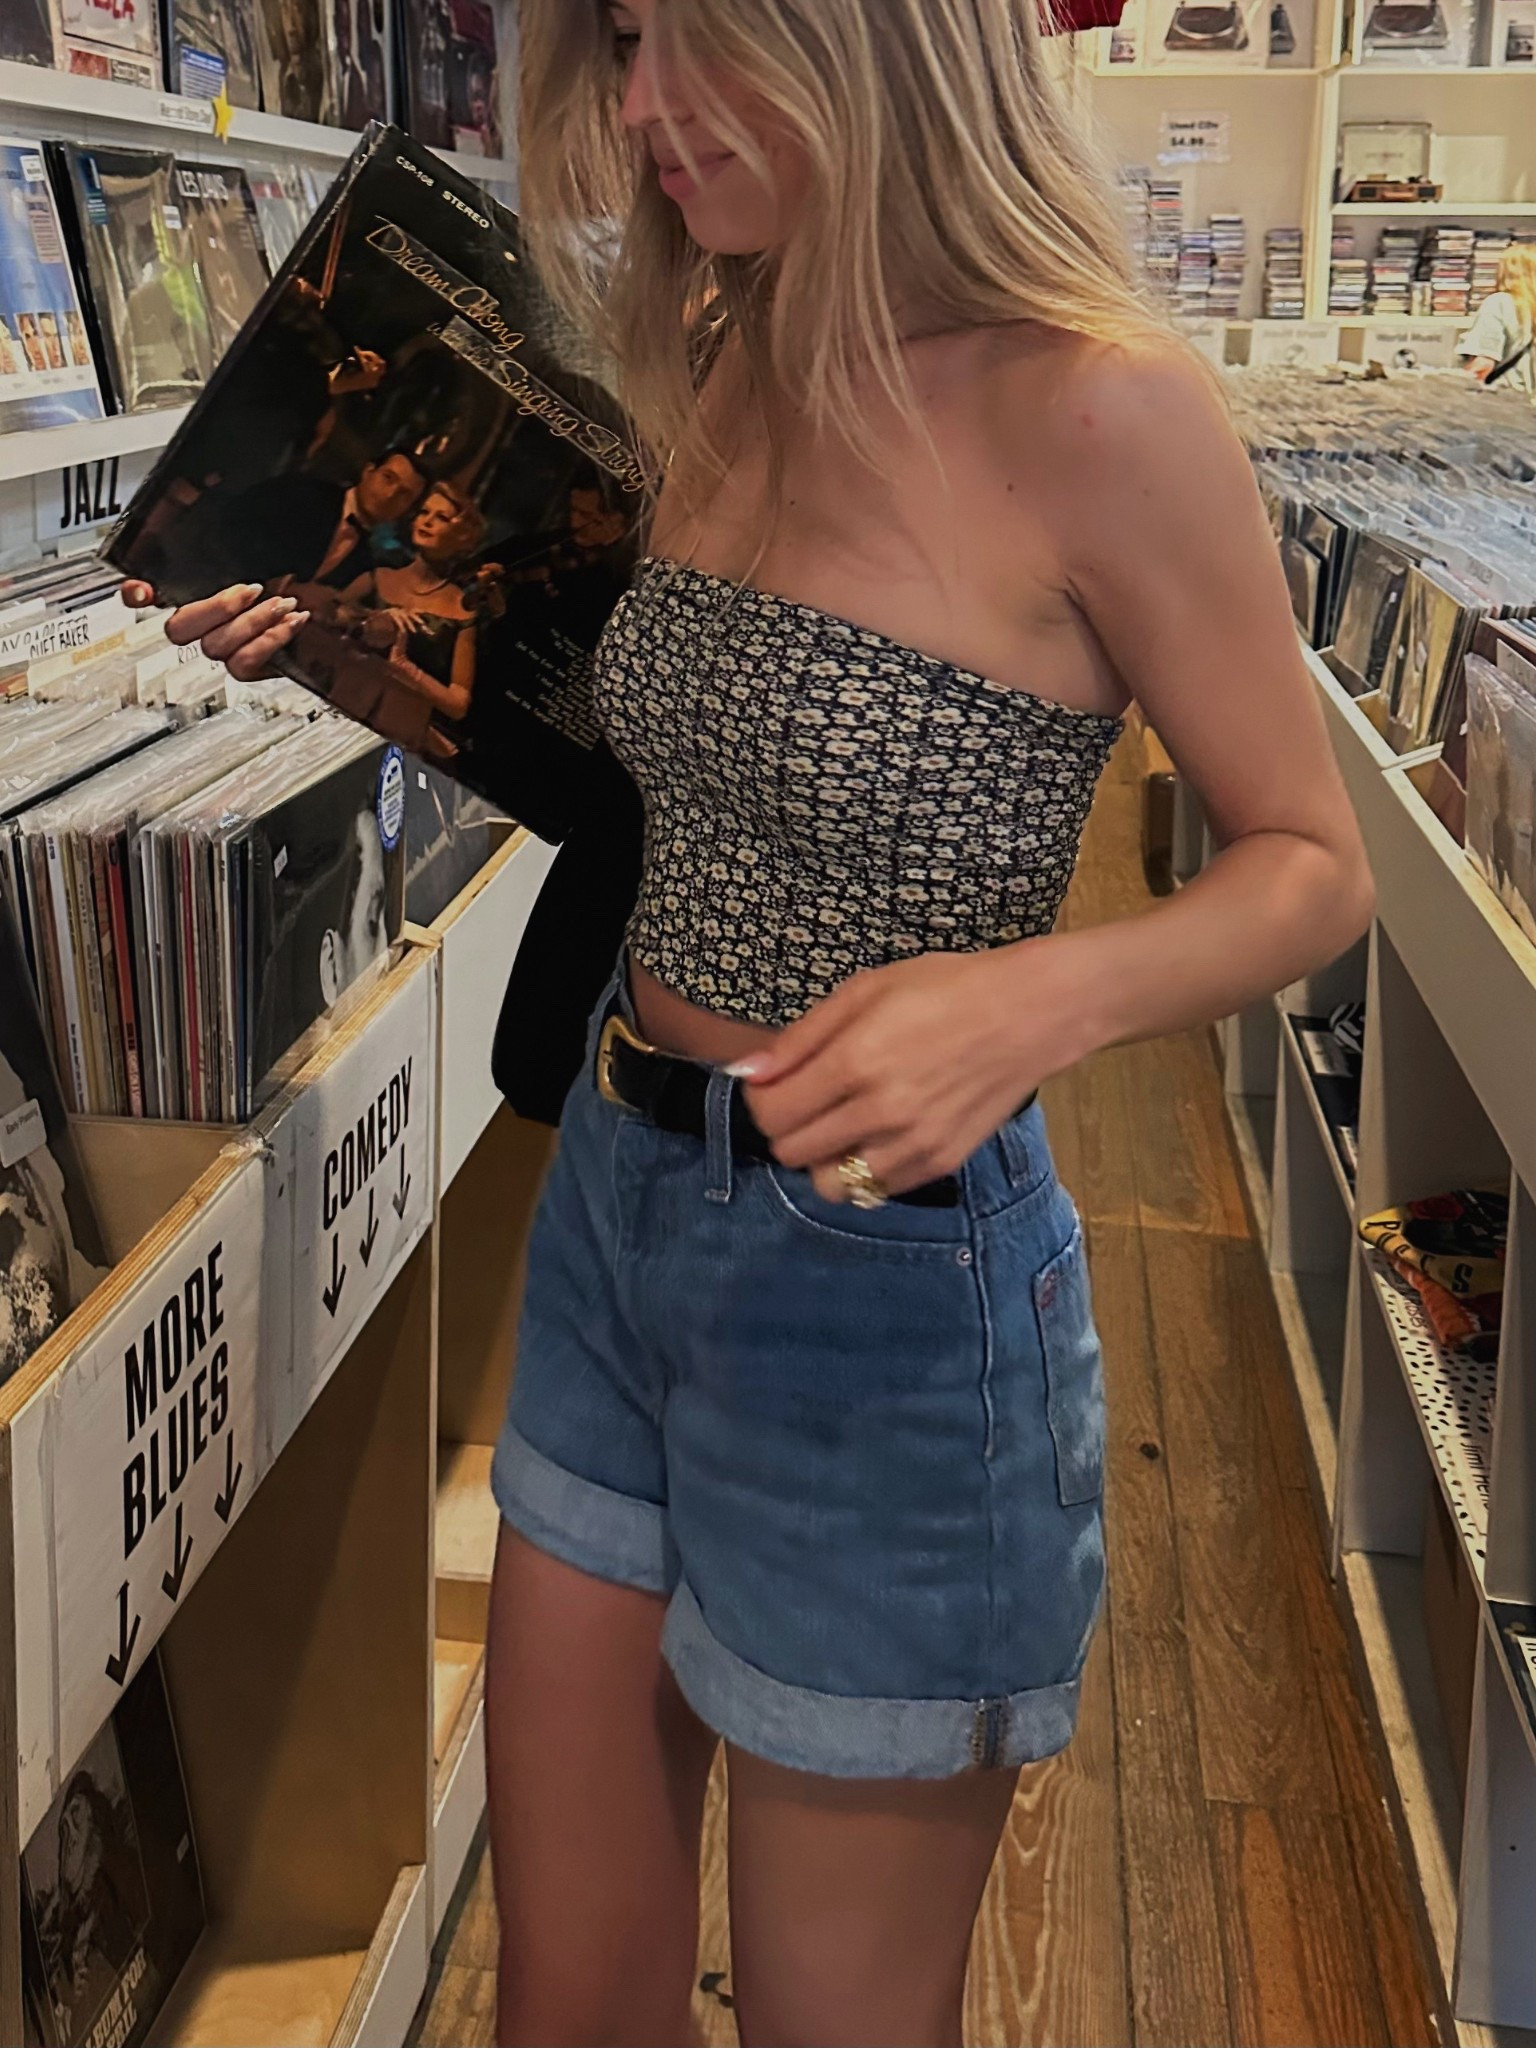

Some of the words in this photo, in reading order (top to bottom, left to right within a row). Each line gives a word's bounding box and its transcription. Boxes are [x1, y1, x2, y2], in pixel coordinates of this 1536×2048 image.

[442, 190, 491, 229] STEREO
[366, 215, 450, 296] Dream
[499, 359, 579, 437] Singing
[60, 455, 122, 529] JAZZ
[323, 1056, 413, 1230] COMEDY
[125, 1240, 225, 1442] MORE
[123, 1340, 230, 1560] BLUES
